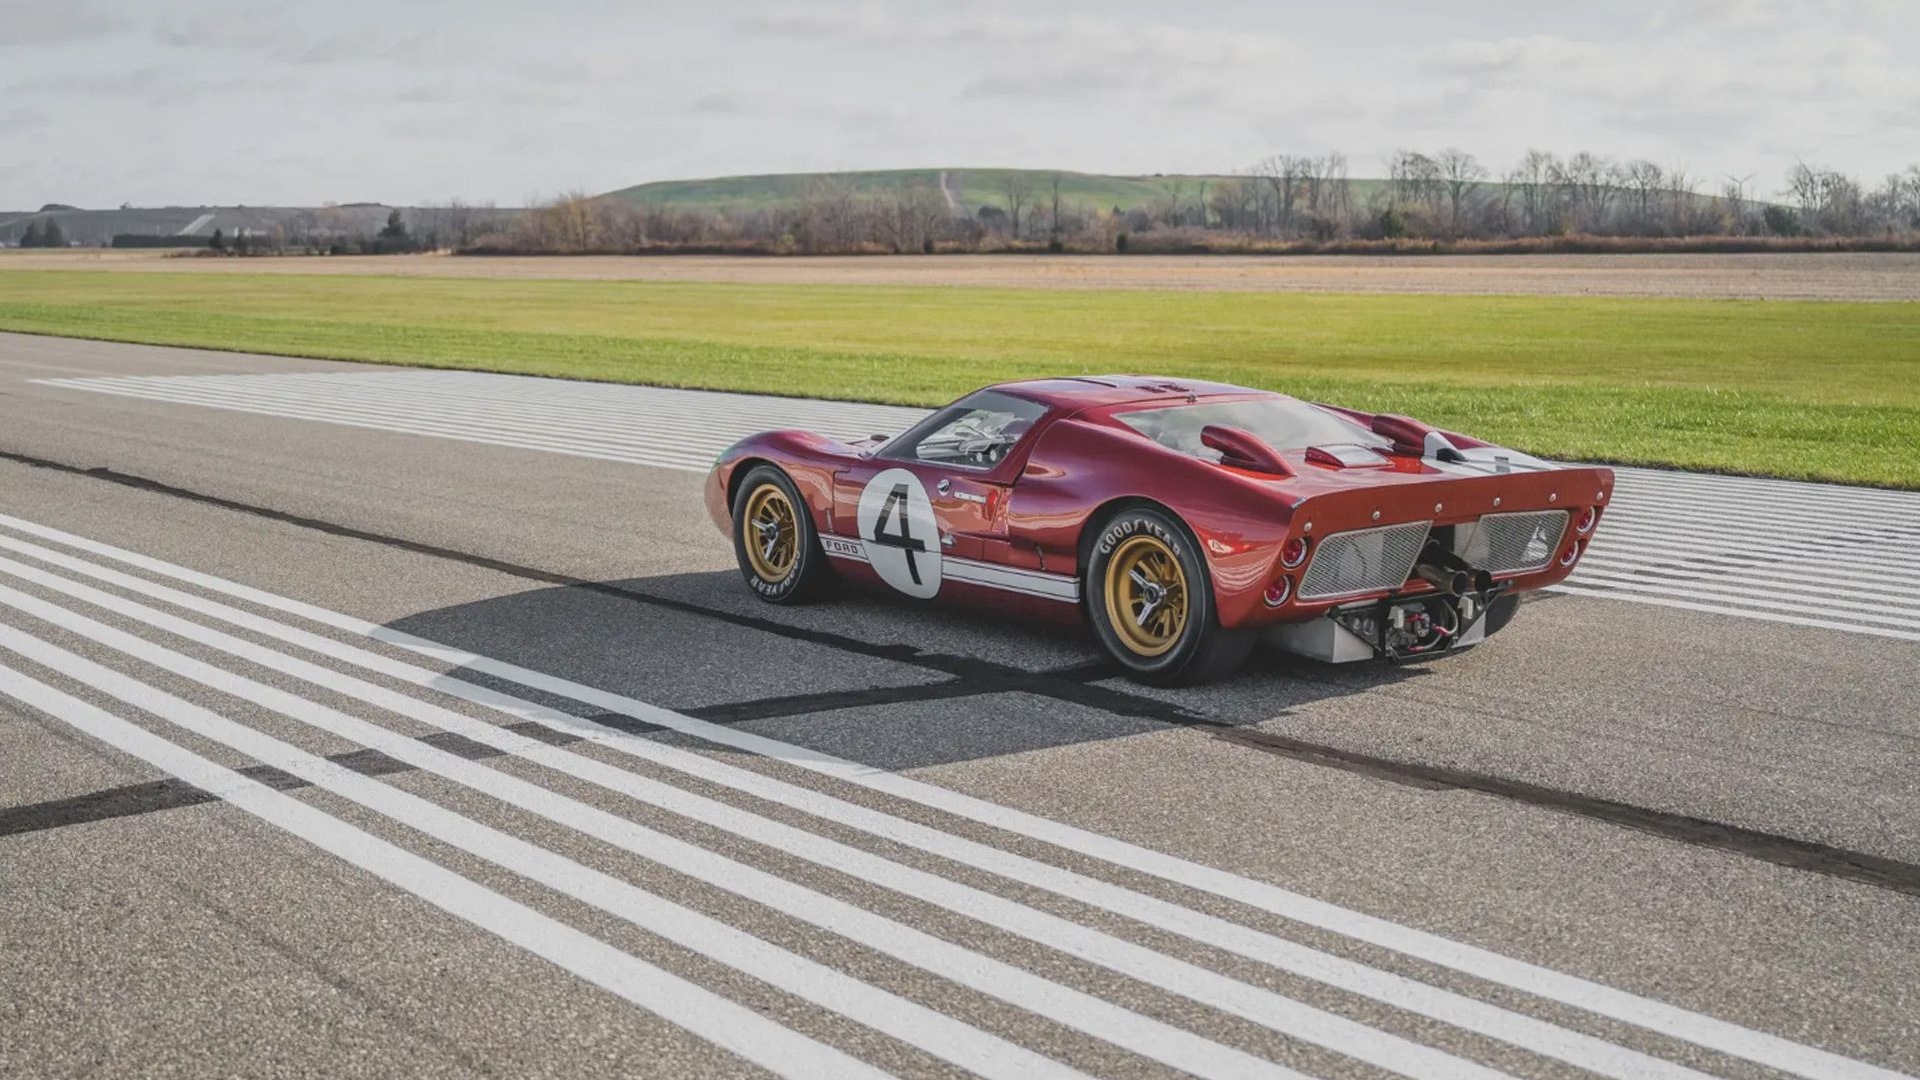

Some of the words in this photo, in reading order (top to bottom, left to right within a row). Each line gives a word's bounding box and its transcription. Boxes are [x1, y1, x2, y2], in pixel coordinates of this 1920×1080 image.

[826, 540, 858, 554] FORD
[874, 483, 926, 585] 4
[1100, 518, 1181, 556] GOODYEAR
